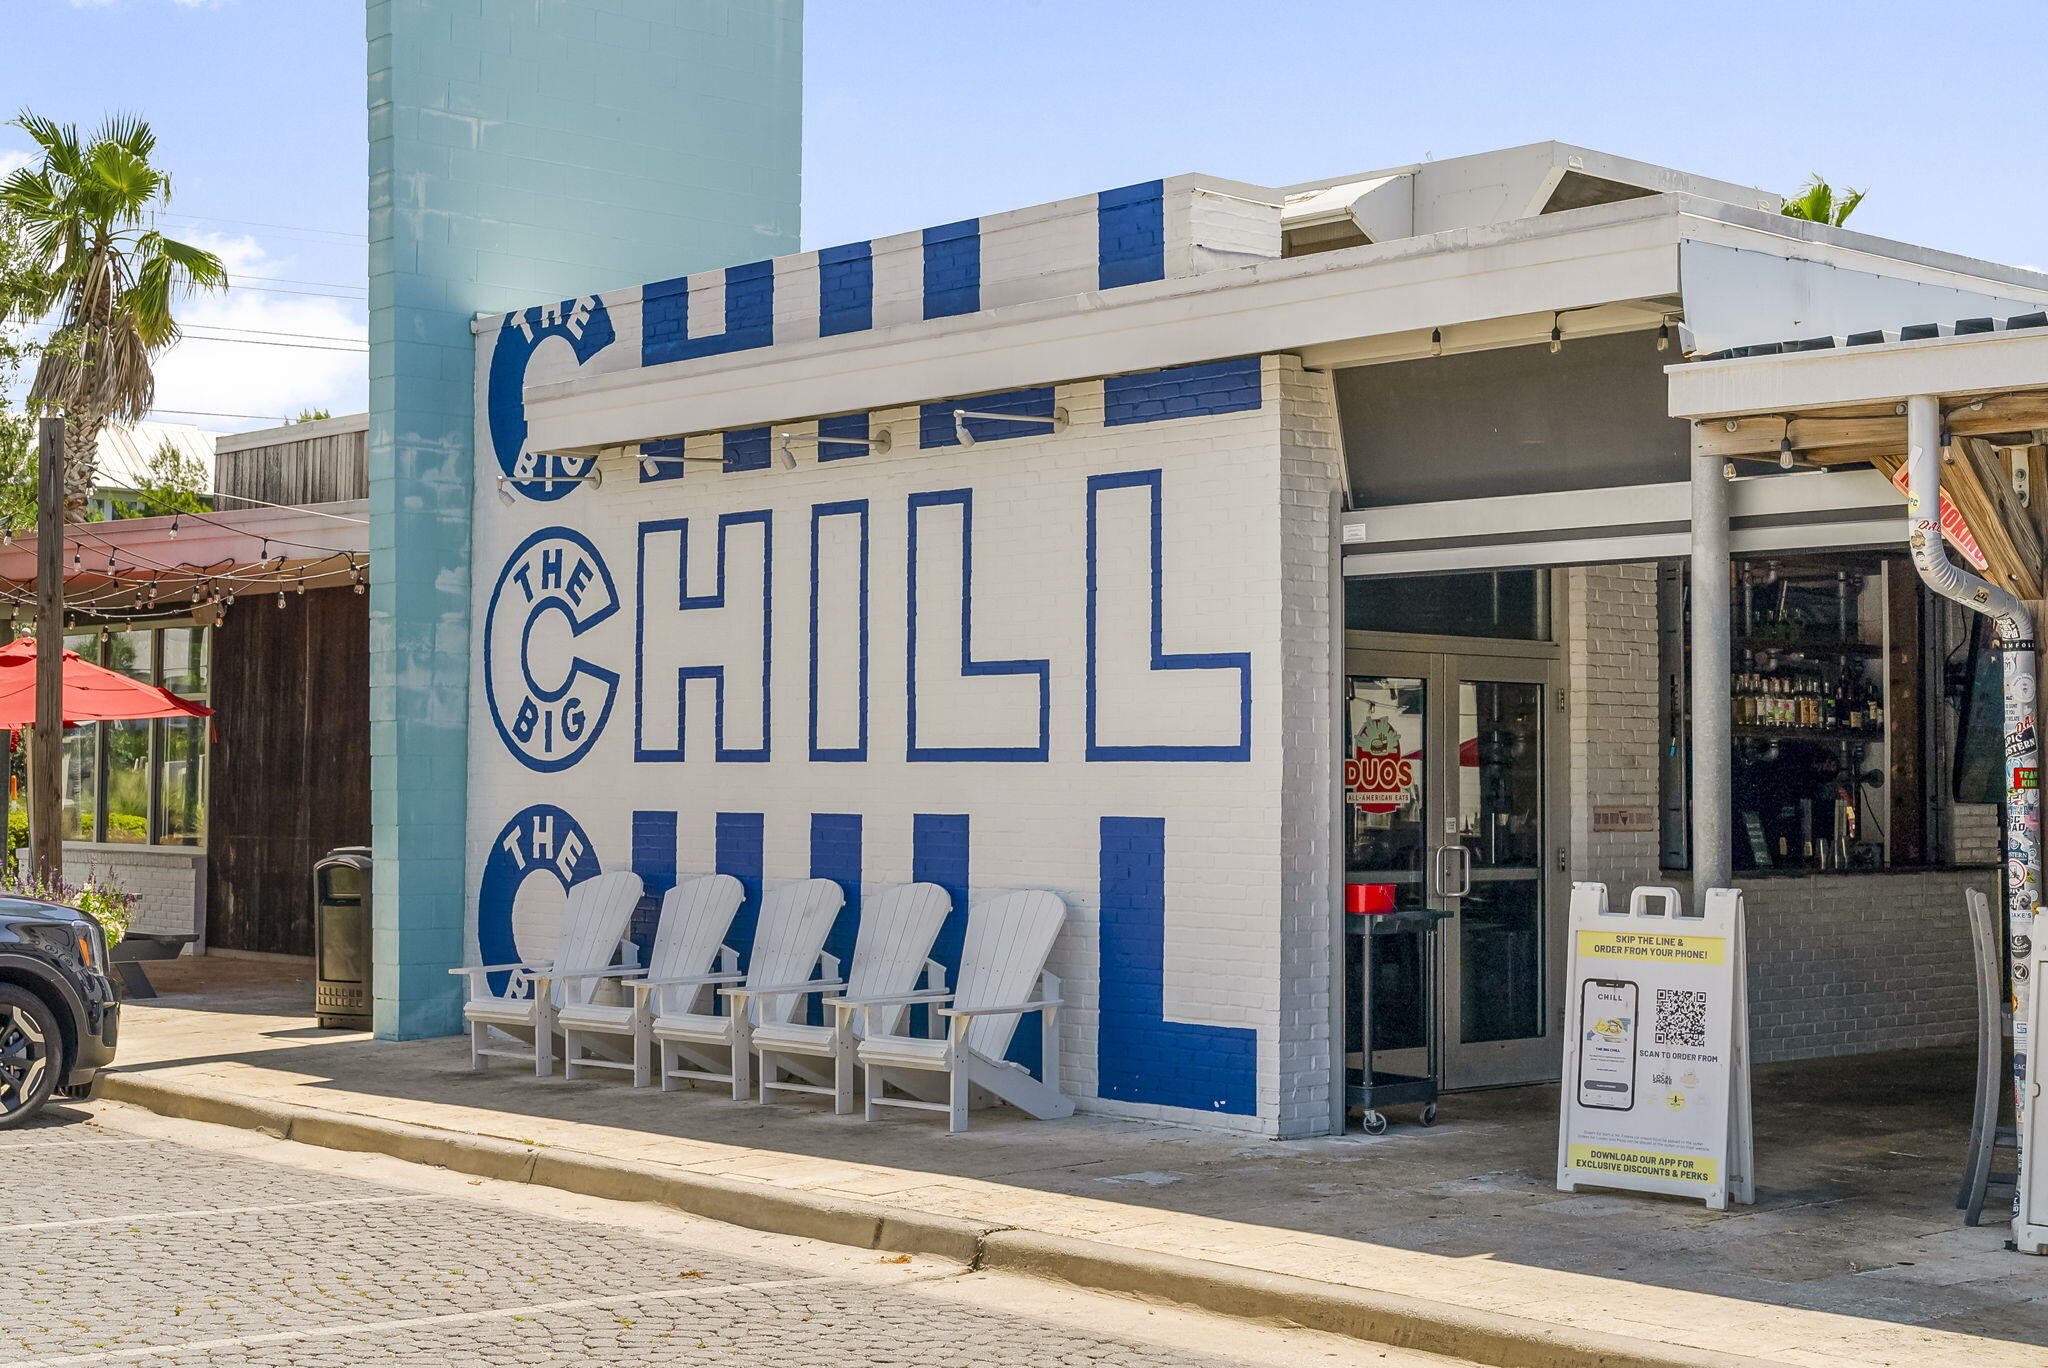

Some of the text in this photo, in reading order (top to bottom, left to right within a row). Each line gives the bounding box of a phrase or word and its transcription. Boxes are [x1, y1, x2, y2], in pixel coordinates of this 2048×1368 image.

[511, 296, 595, 343] THE
[513, 549, 594, 607] THE
[484, 469, 1252, 773] CHILL
[512, 695, 586, 752] BIG
[1345, 759, 1412, 788] DUOS
[503, 816, 583, 882] THE
[1594, 945, 1708, 959] ORDER FROM YOUR PHONE!
[1616, 935, 1684, 947] SKIP THE LINE &
[1597, 993, 1623, 1001] CHILL
[1639, 1049, 1718, 1063] SCAN TO ORDER FROM
[1576, 1159, 1709, 1181] EXCLUSIVE DISCOUNTS & PERKS
[1590, 1150, 1694, 1169] DOWNLOAD OUR APP FOR
